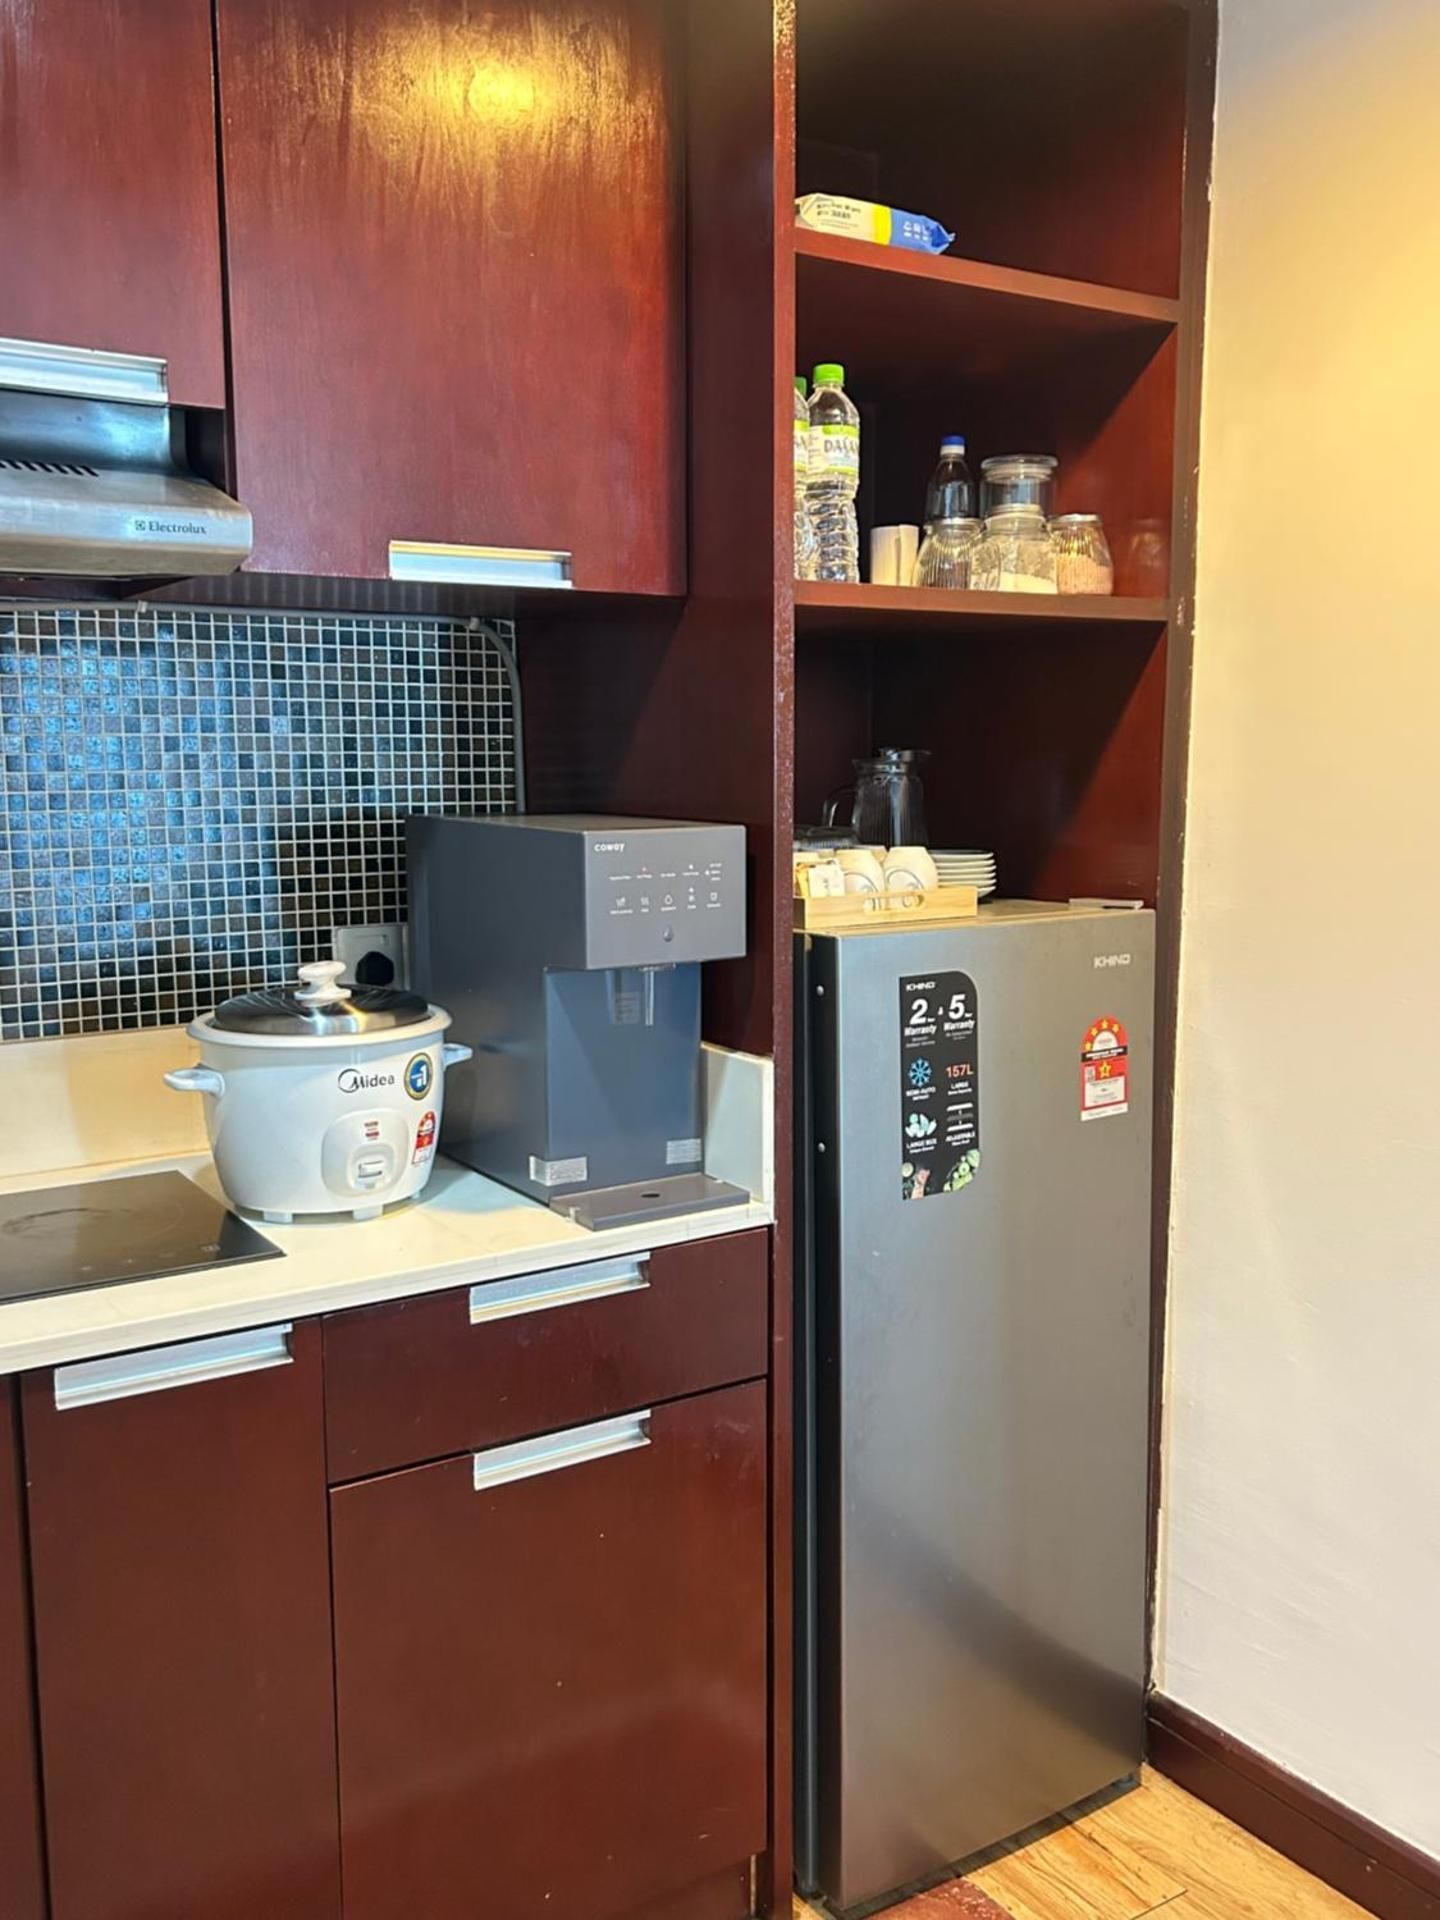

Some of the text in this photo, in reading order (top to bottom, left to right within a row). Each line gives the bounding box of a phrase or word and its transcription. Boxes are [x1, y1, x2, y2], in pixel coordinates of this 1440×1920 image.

[148, 520, 207, 534] Electrolux
[909, 998, 929, 1025] 2
[948, 994, 966, 1020] 5
[904, 1024, 936, 1036] Warranty
[943, 1019, 975, 1031] Warranty
[946, 1063, 974, 1078] 157L
[338, 1068, 395, 1093] Midea
